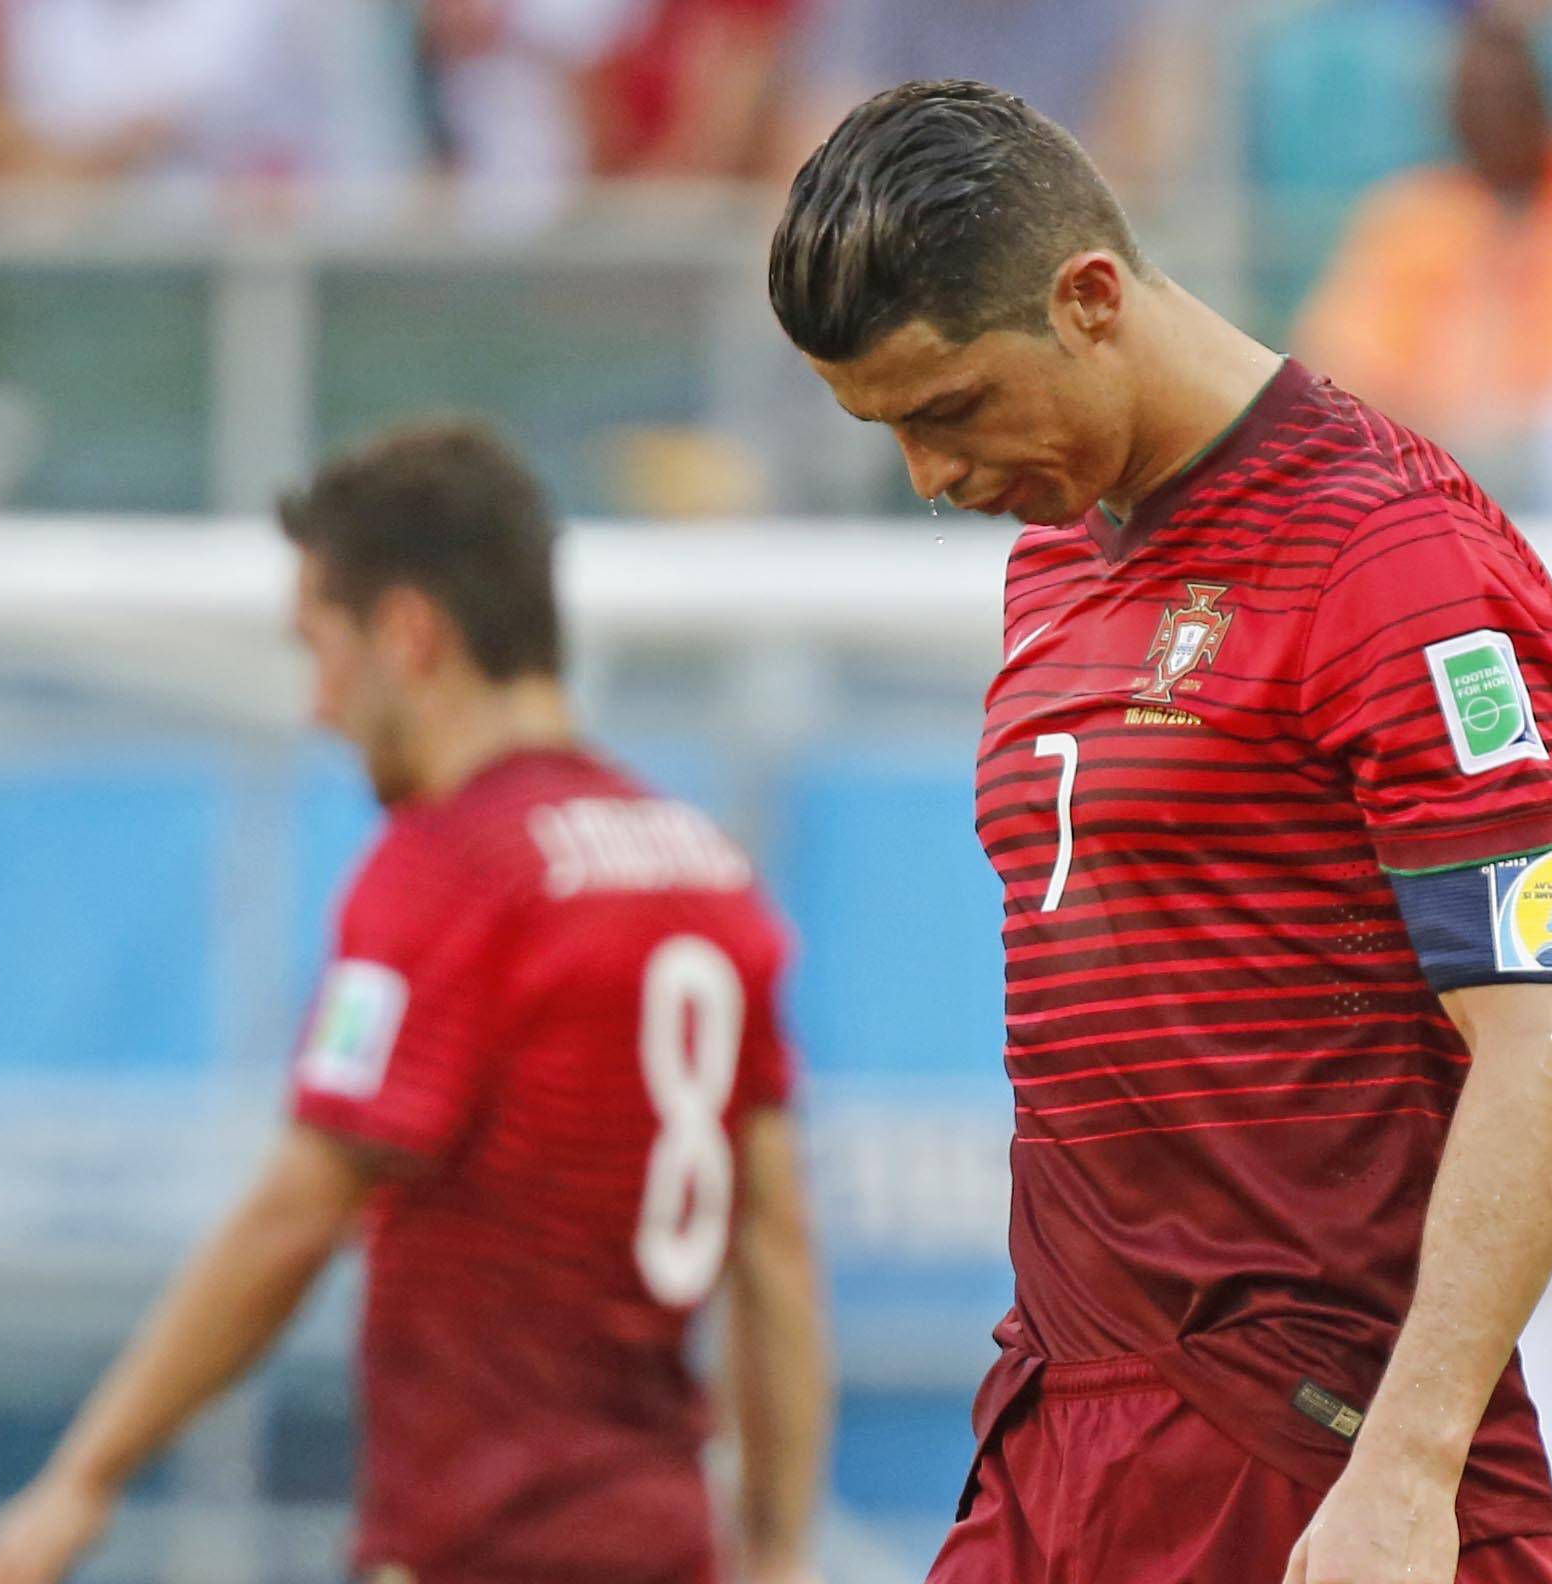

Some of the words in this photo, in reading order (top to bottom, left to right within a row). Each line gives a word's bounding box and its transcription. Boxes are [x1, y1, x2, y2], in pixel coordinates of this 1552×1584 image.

[1456, 682, 1482, 698] FOR
[1033, 732, 1080, 914] 7
[1522, 891, 1533, 900] IS
[634, 930, 745, 1305] 8
